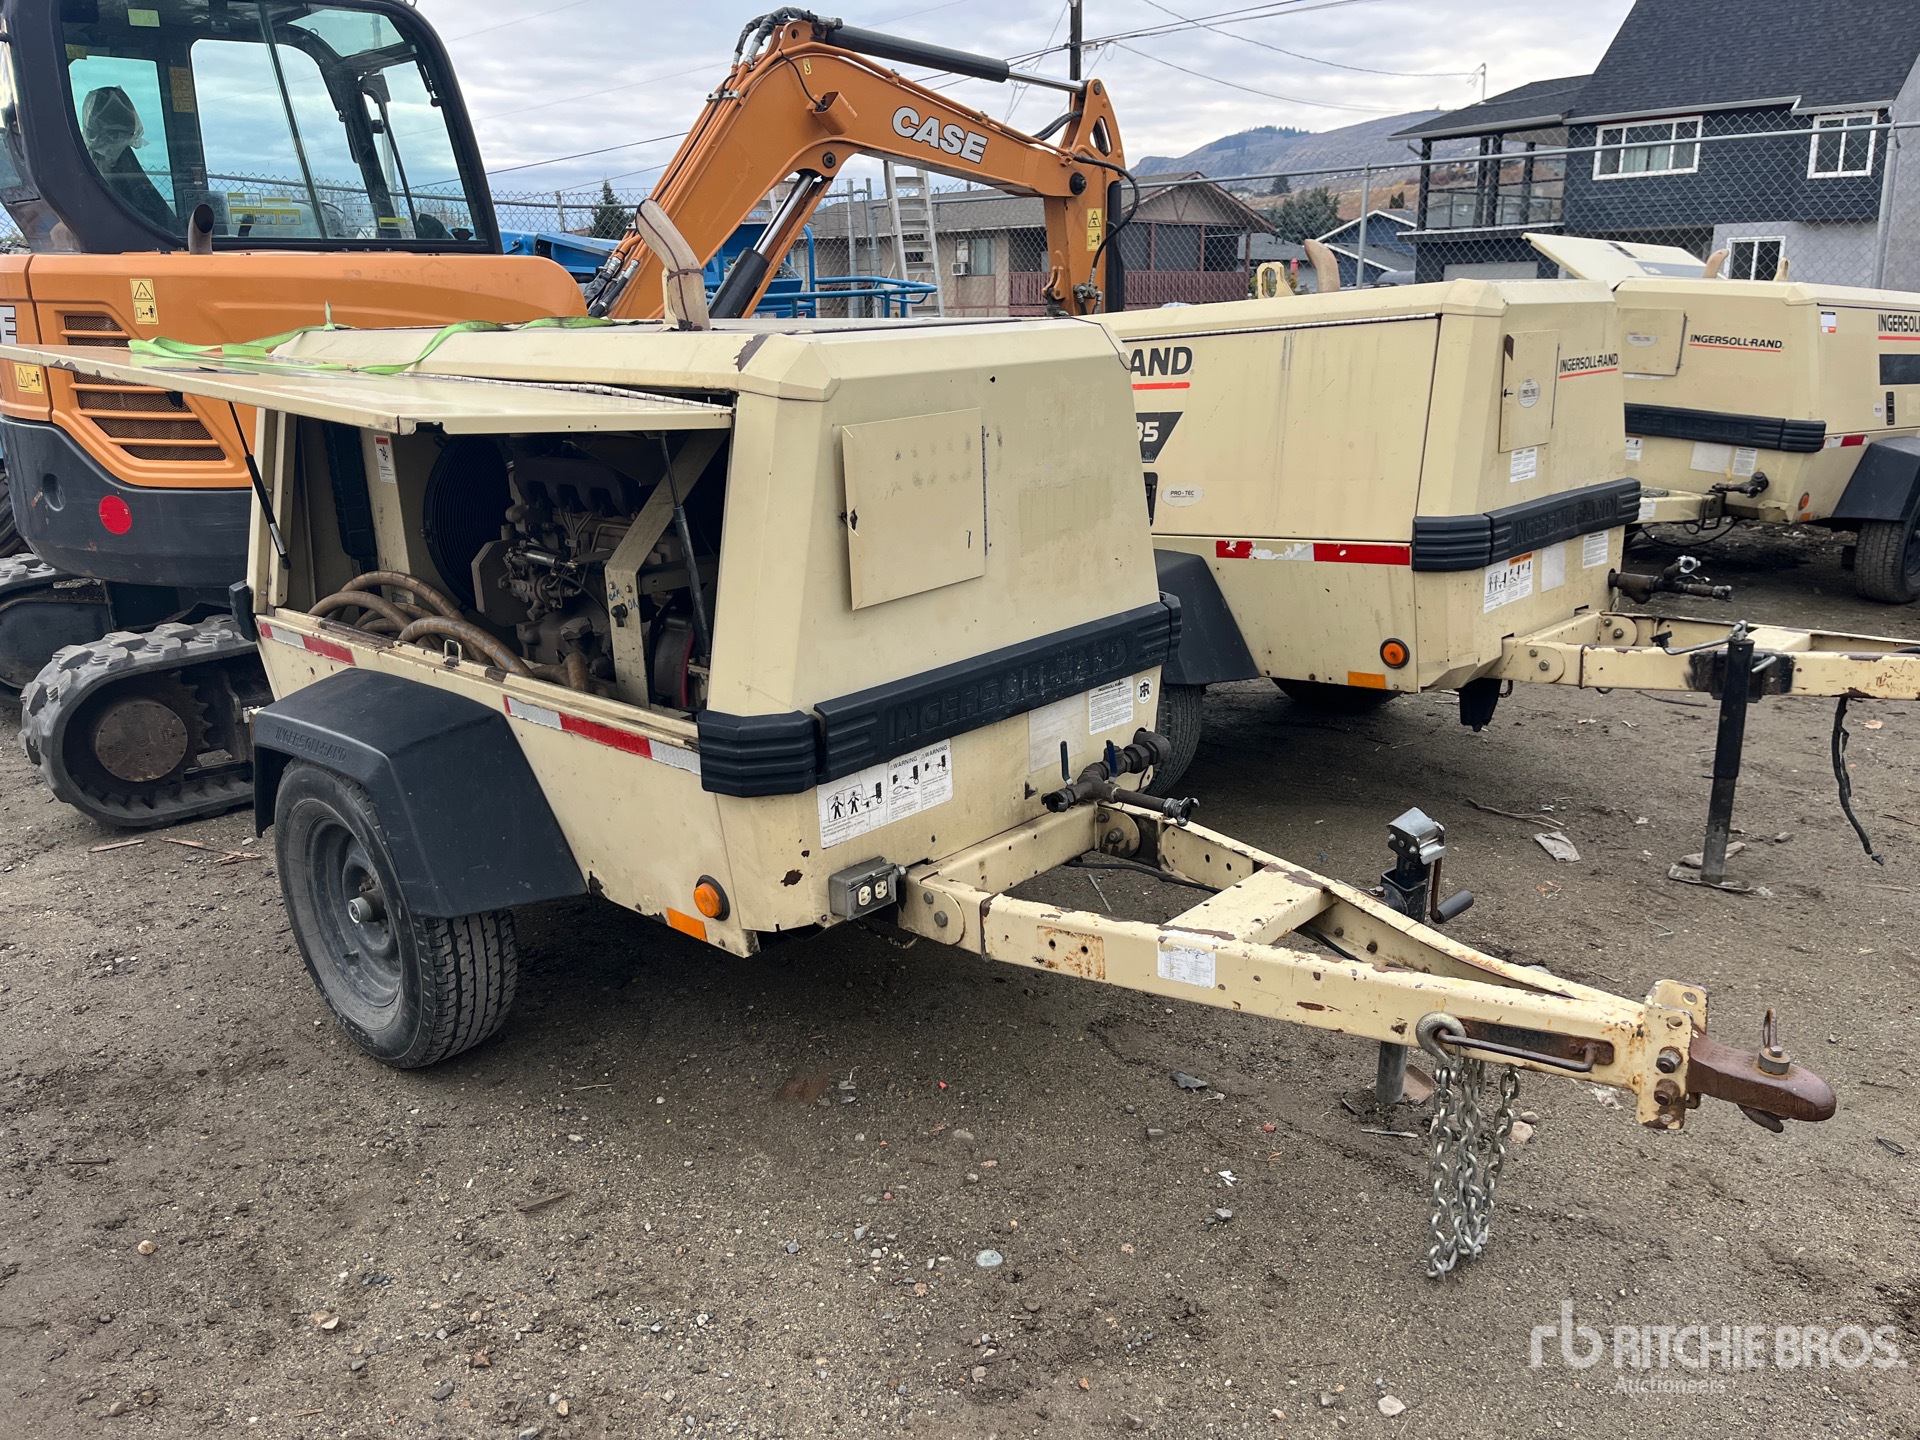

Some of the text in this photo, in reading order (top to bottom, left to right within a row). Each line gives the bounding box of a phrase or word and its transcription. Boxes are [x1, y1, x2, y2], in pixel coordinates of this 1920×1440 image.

[892, 106, 989, 164] CASE
[1690, 334, 1783, 349] INGERSOLL-RAND
[1130, 346, 1193, 377] AND
[1559, 353, 1618, 373] INGERSOLL-RAND
[925, 744, 948, 758] WARNING
[893, 755, 918, 768] WARNING
